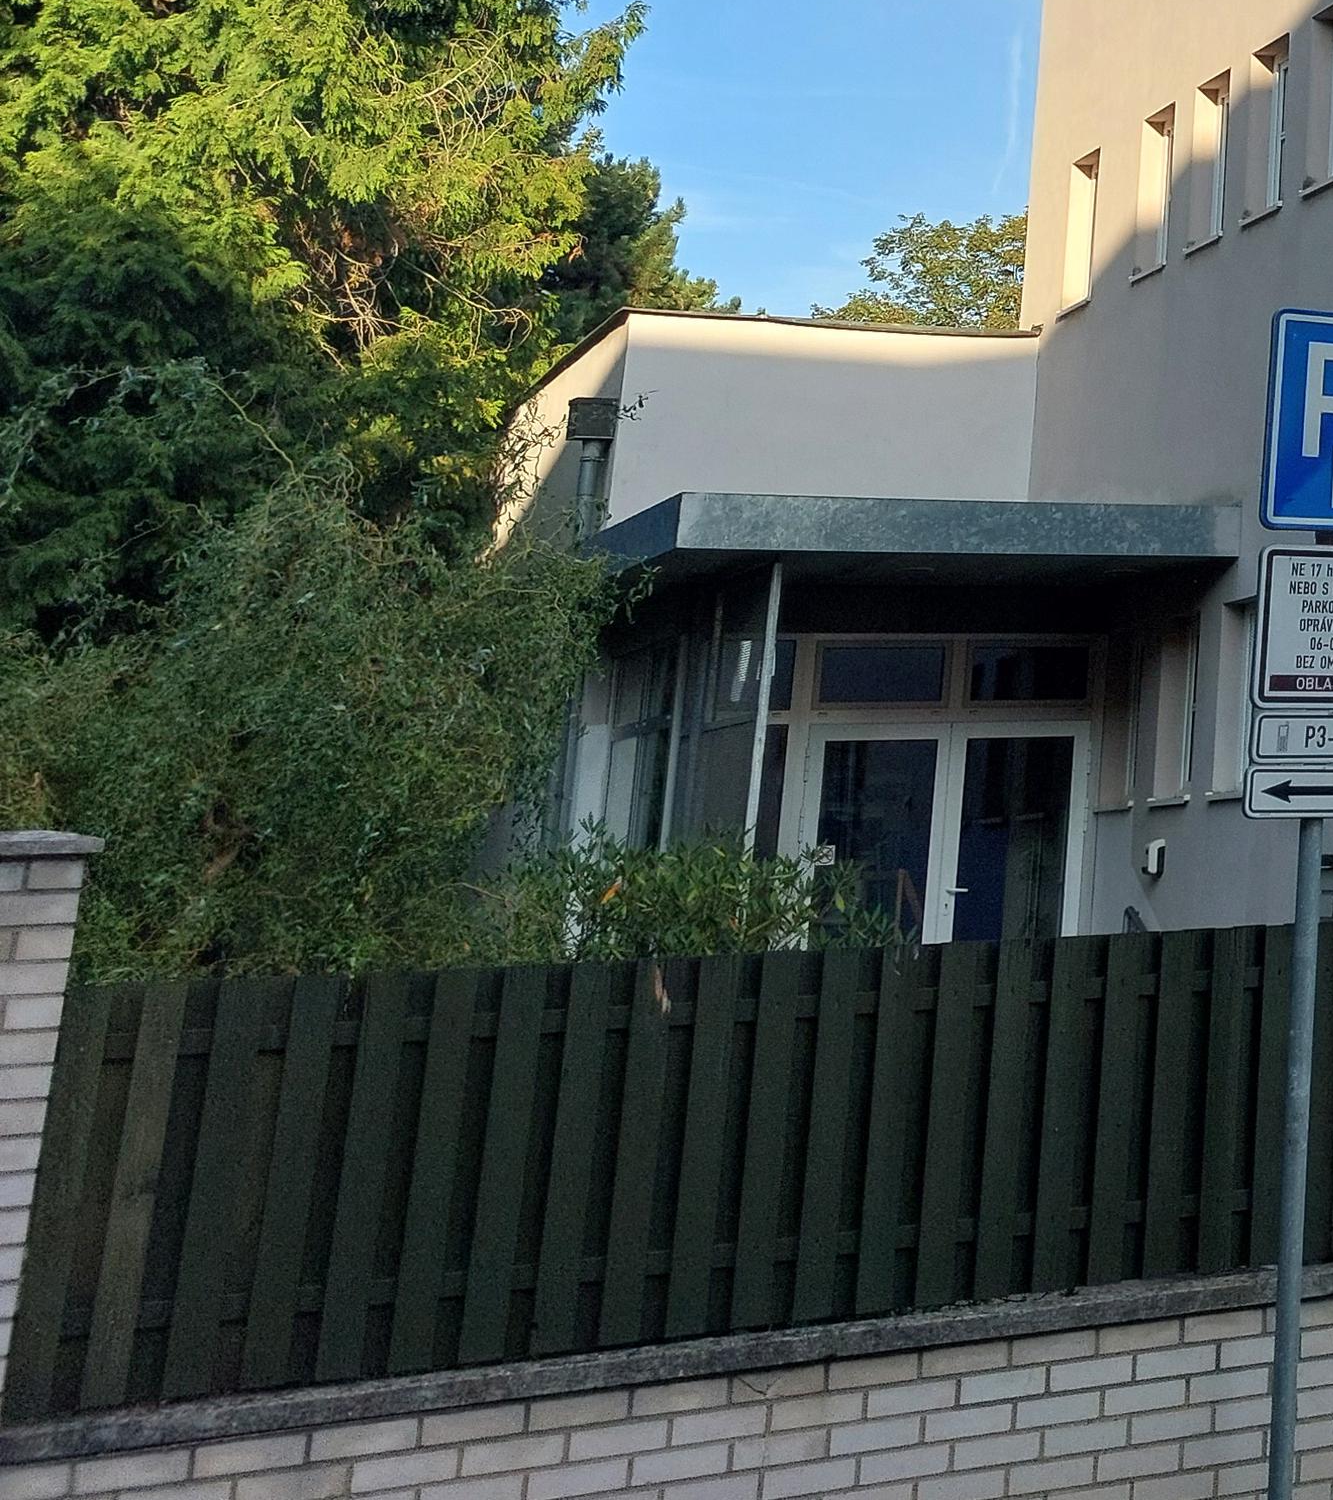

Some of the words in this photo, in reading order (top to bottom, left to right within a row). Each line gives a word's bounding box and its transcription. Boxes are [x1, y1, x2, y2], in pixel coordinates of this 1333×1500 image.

[1291, 562, 1306, 577] NE
[1311, 563, 1322, 578] 17
[1289, 580, 1318, 595] NEBO
[1321, 582, 1329, 596] S
[1295, 655, 1316, 669] BEZ
